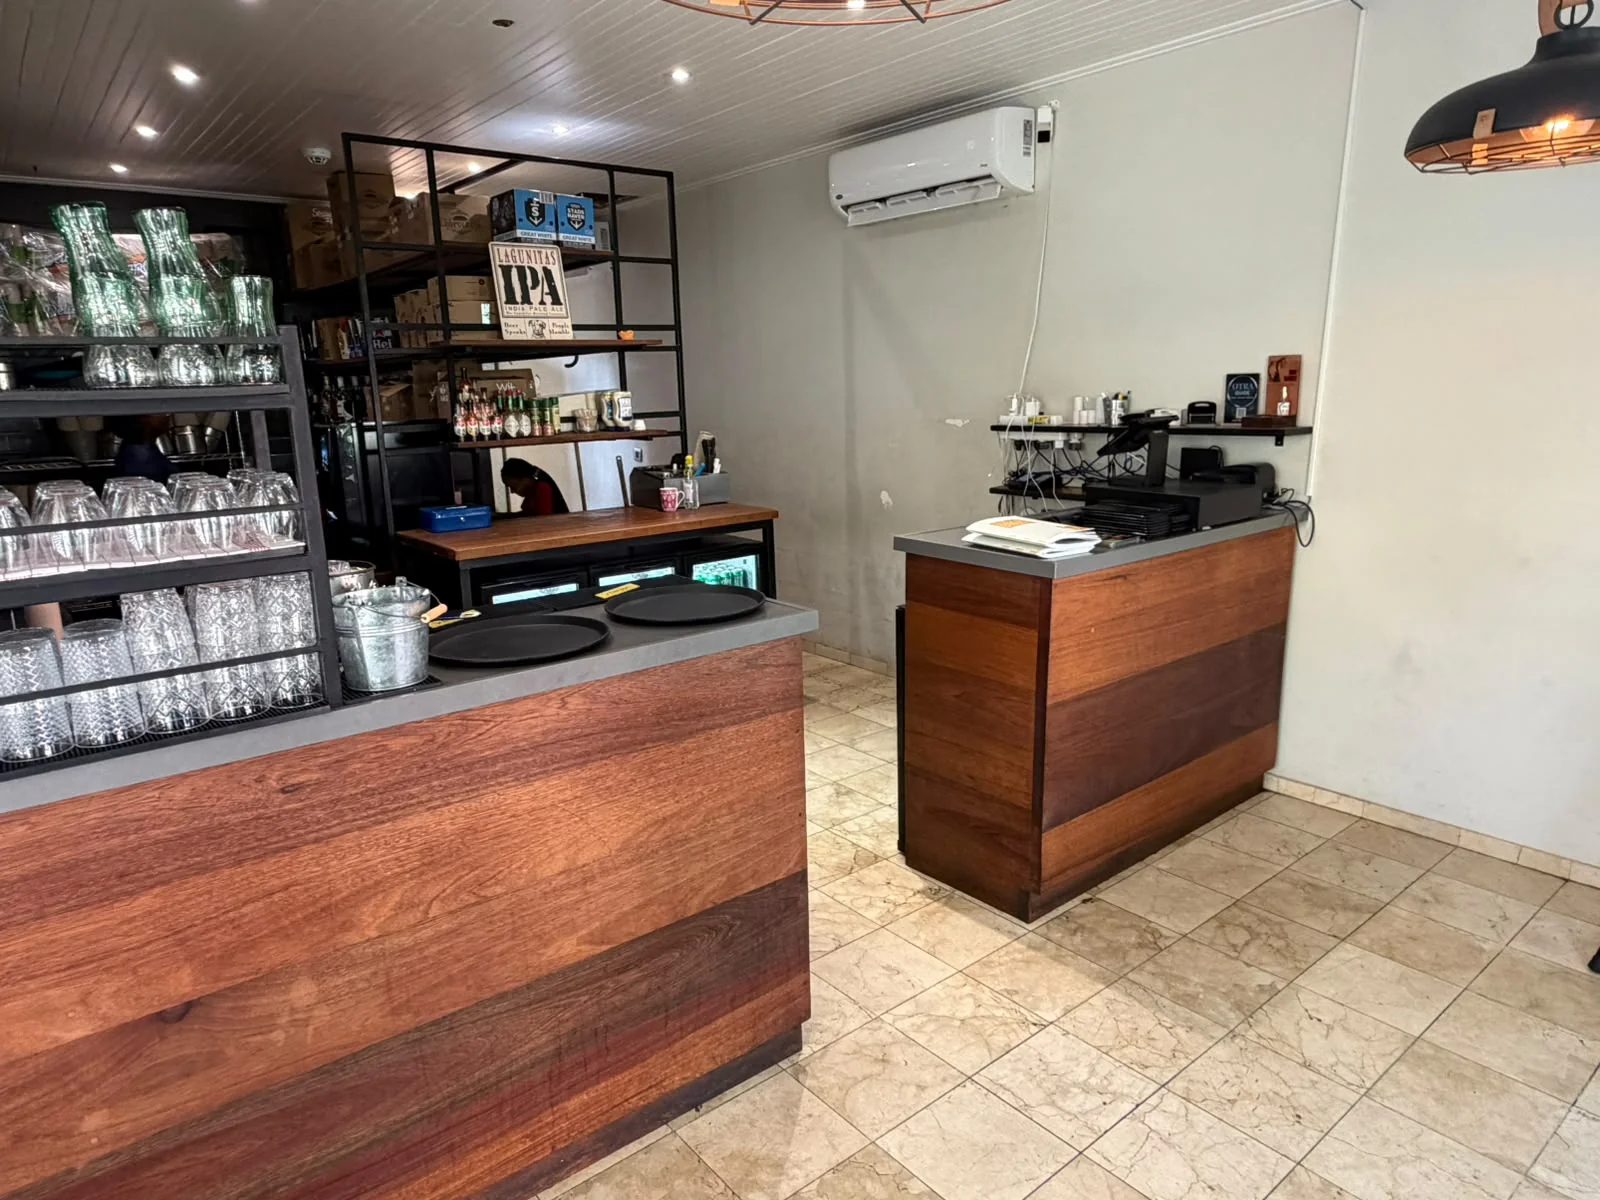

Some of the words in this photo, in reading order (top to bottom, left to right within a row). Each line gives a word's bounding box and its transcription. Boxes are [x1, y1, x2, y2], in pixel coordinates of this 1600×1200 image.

[532, 206, 540, 216] S
[496, 248, 556, 265] LAGUNITAS
[498, 265, 564, 306] IPA
